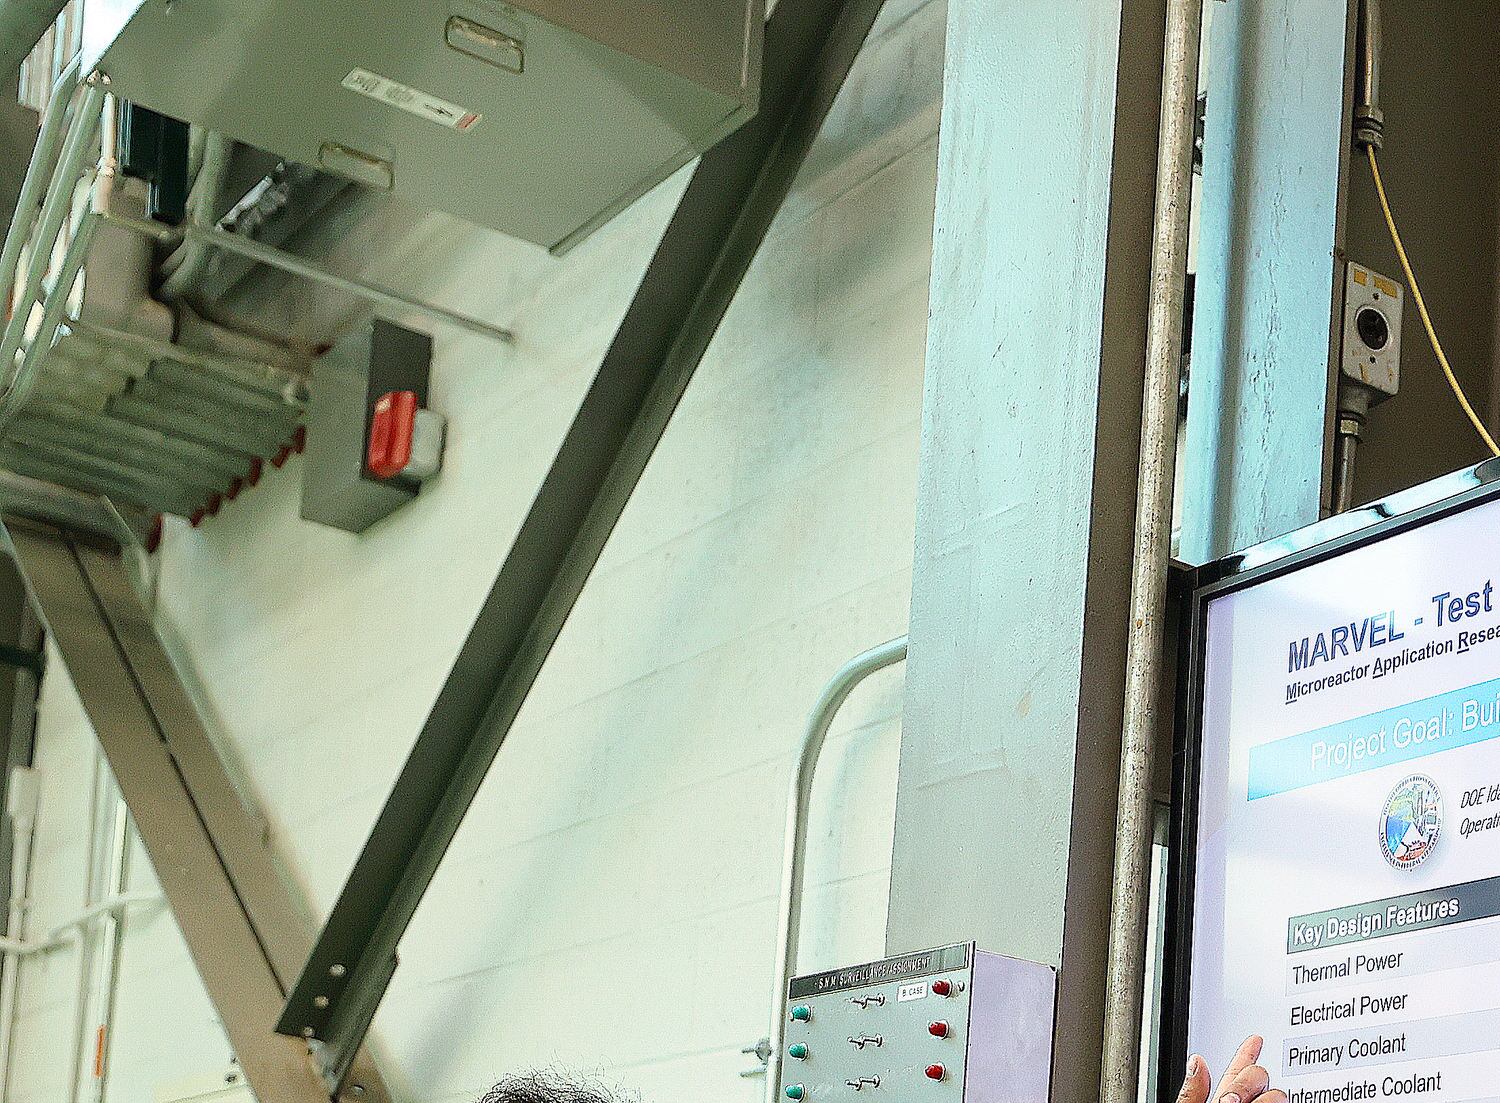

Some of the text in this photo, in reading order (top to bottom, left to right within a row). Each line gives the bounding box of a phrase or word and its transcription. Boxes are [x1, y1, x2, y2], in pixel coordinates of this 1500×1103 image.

[1288, 610, 1404, 673] MARVEL
[1414, 617, 1423, 625] -
[1432, 579, 1492, 627] Test
[1285, 663, 1370, 705] Microreactor
[1372, 640, 1453, 679] Application
[1310, 727, 1387, 770] Project
[1393, 709, 1453, 749] Goal:
[1460, 787, 1486, 808] DOE
[1292, 898, 1460, 947] Key Design Features
[1292, 952, 1404, 985] Thermal Power
[1290, 994, 1408, 1026] Electrical Power
[1288, 1032, 1406, 1067] Primary Coolant
[1382, 1071, 1442, 1096] Coolant
